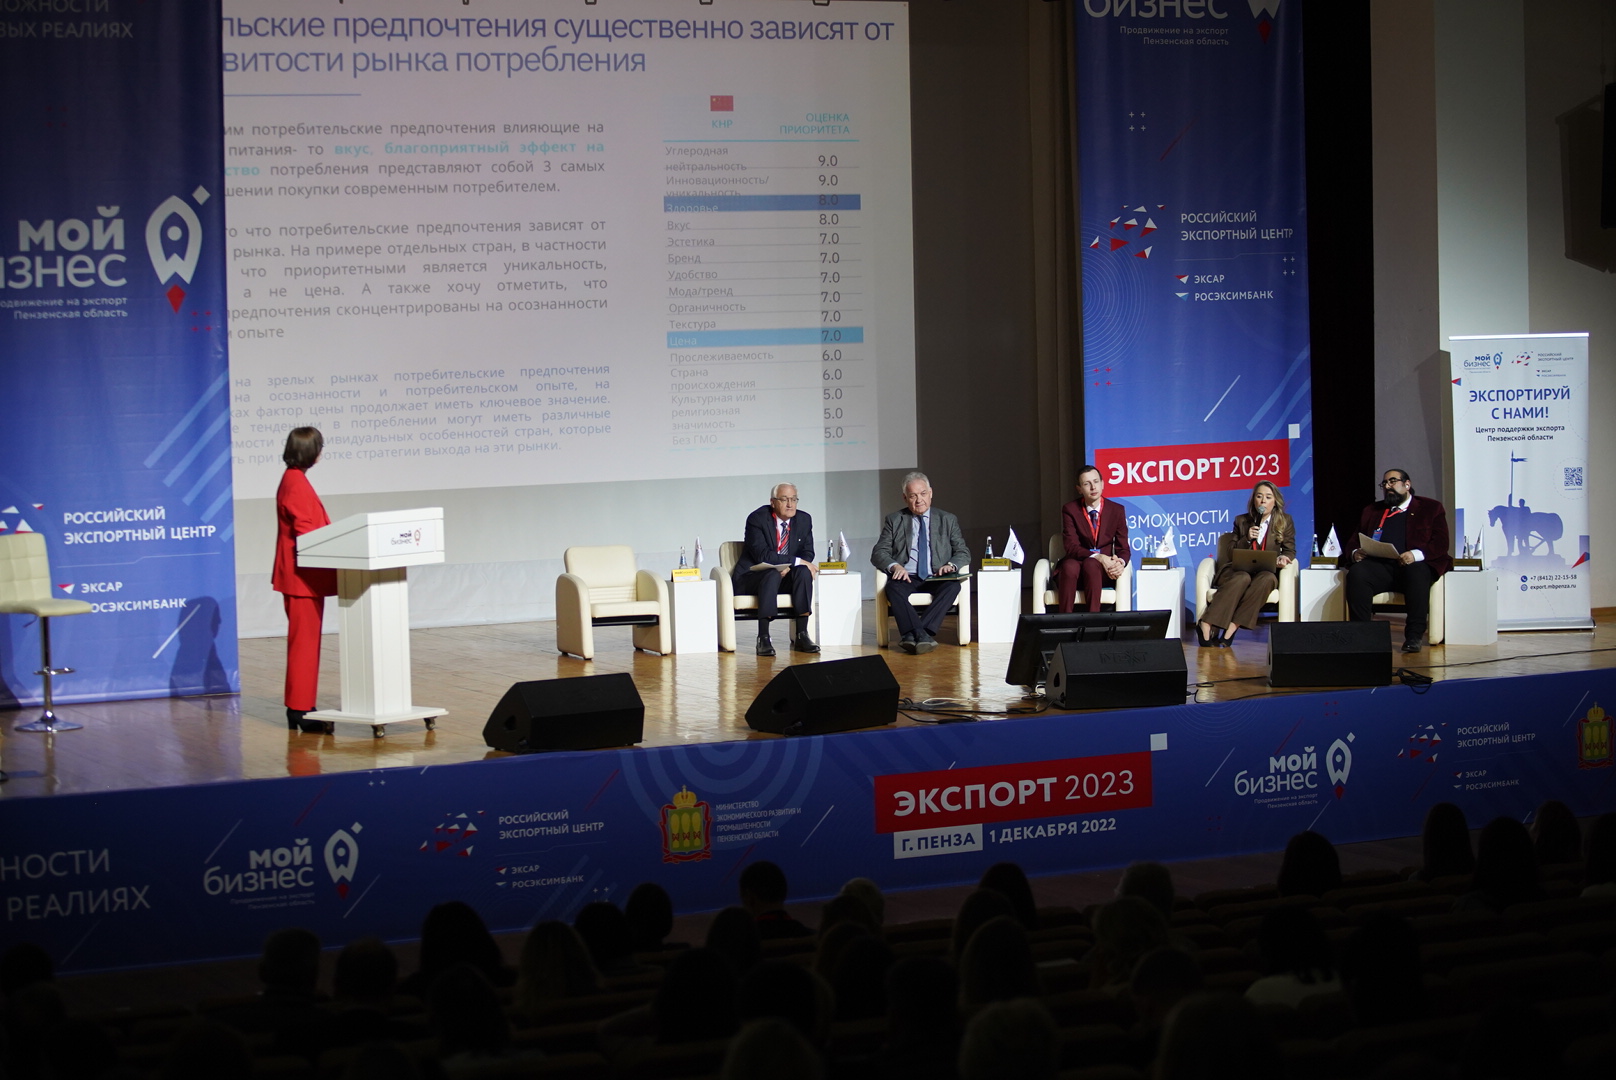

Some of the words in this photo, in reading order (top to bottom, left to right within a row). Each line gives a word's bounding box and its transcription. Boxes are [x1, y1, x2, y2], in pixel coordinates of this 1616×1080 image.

[0, 0, 109, 13] ОЖНОСТИ
[42, 22, 133, 38] РЕАЛИЯХ
[333, 17, 546, 43] предпочтения
[554, 18, 743, 44] существенно
[750, 20, 859, 40] зависят
[864, 21, 894, 40] от
[1120, 26, 1180, 36] Продвижение
[1196, 27, 1228, 36] экспорт
[1144, 37, 1194, 45] Пензенская
[1196, 36, 1229, 46] область
[352, 51, 448, 78] рынка
[456, 44, 645, 78] потребления
[806, 113, 850, 122] ОЦЕНКА
[251, 122, 382, 138] потребительские
[390, 123, 495, 137] предпочтения
[503, 123, 580, 135] влияющие
[587, 123, 604, 133] на
[712, 120, 733, 128] КНР
[780, 126, 850, 134] ПРИОРИТЕТА
[228, 145, 297, 156] питания-
[306, 145, 324, 155] то
[334, 145, 372, 157] вкус,
[384, 140, 509, 156] благоприятный
[519, 140, 576, 155] эффект
[586, 143, 604, 152] на
[818, 155, 838, 166] 9.0
[270, 161, 368, 178] потребления
[378, 163, 482, 177] представляют
[490, 160, 533, 172] собой
[543, 160, 551, 172] 3
[560, 162, 604, 172] самых
[818, 175, 838, 186] 9.0
[278, 185, 339, 199] покупки
[344, 184, 448, 197] современным
[452, 180, 560, 196] потребителем.
[819, 214, 839, 225] 8.0
[1181, 210, 1257, 224] РОССИЙСКИЙ
[18, 206, 125, 252] мой
[667, 221, 691, 232] Вкус
[820, 233, 839, 244] 7.0
[1181, 228, 1257, 241] ЭКСПОРТНЫЙ
[1261, 228, 1293, 242] ЦЕНТР
[667, 238, 715, 247] Эстетика
[668, 253, 701, 264] Бренд
[820, 252, 840, 263] 7.0
[0, 254, 127, 289] знес
[240, 267, 266, 277] что
[284, 264, 406, 279] приоритетными
[422, 262, 487, 273] является
[503, 260, 606, 274] уникальность,
[668, 270, 718, 280] Удобство
[820, 272, 840, 283] 7.0
[1194, 274, 1225, 284] ЭКСАР
[821, 291, 841, 302] 7.0
[1194, 290, 1274, 301] РОСЭКСИМБАНК
[67, 298, 80, 306] на
[82, 297, 128, 307] экспорт
[14, 310, 80, 319] Пензенская
[83, 309, 128, 318] область
[821, 311, 841, 322] 7.0
[669, 320, 716, 331] Текстура
[822, 330, 841, 341] 7.0
[822, 350, 842, 361] 6.0
[235, 378, 251, 387] на
[267, 376, 314, 388] зрелых
[330, 373, 378, 386] рынках
[394, 368, 505, 384] потребительские
[520, 365, 610, 379] предпочтения
[823, 369, 842, 380] 6.0
[823, 388, 842, 400] 5.0
[1469, 386, 1570, 402] ЭКСПОРТИРУЙ
[824, 408, 843, 419] 5.0
[1491, 407, 1499, 420] С
[1504, 406, 1549, 419] НАМИ!
[824, 427, 843, 438] 5.0
[1476, 426, 1495, 434] Центр
[1497, 426, 1534, 434] поддержки
[1108, 457, 1225, 485] ЭКСПОРТ
[1229, 454, 1280, 477] 2023
[64, 506, 166, 524] РОССИЙСКИЙ
[64, 526, 166, 545] ЭКСПОРТНЫЙ
[171, 525, 216, 541] ЦЕНТР
[81, 582, 123, 594] ЭКСАР
[1458, 722, 1510, 735] РОССИЙСКИЙ
[1458, 734, 1510, 748] ЭКСПОРТНЫЙ
[1512, 733, 1536, 743] ЦЕНТР
[1270, 746, 1317, 773] мой
[1466, 770, 1487, 778] ЭКСАР
[1234, 770, 1318, 796] бизнес
[1466, 779, 1519, 790] РОСЭКСИМБАНК
[894, 776, 1057, 816] ЭКСПОРТ
[1065, 770, 1134, 800] 2023
[716, 800, 759, 810] МИНИСТЕРСТВО
[499, 809, 569, 825] РОССИЙСКИЙ
[499, 824, 569, 839] ЭКСПОРТНЫЙ
[572, 822, 604, 834] ЦЕНТР
[902, 839, 914, 852] Г.
[917, 832, 975, 850] ПЕНЗА
[989, 830, 996, 843] 1
[999, 821, 1077, 844] ДЕКАБРЯ
[1082, 817, 1116, 834] 2022
[250, 838, 312, 870] мой
[512, 865, 540, 874] ЭКСАР
[204, 866, 314, 896] бизнес
[512, 875, 584, 888] РОСЭКСИМБАНК
[7, 885, 150, 921] РЕАЛИЯХ
